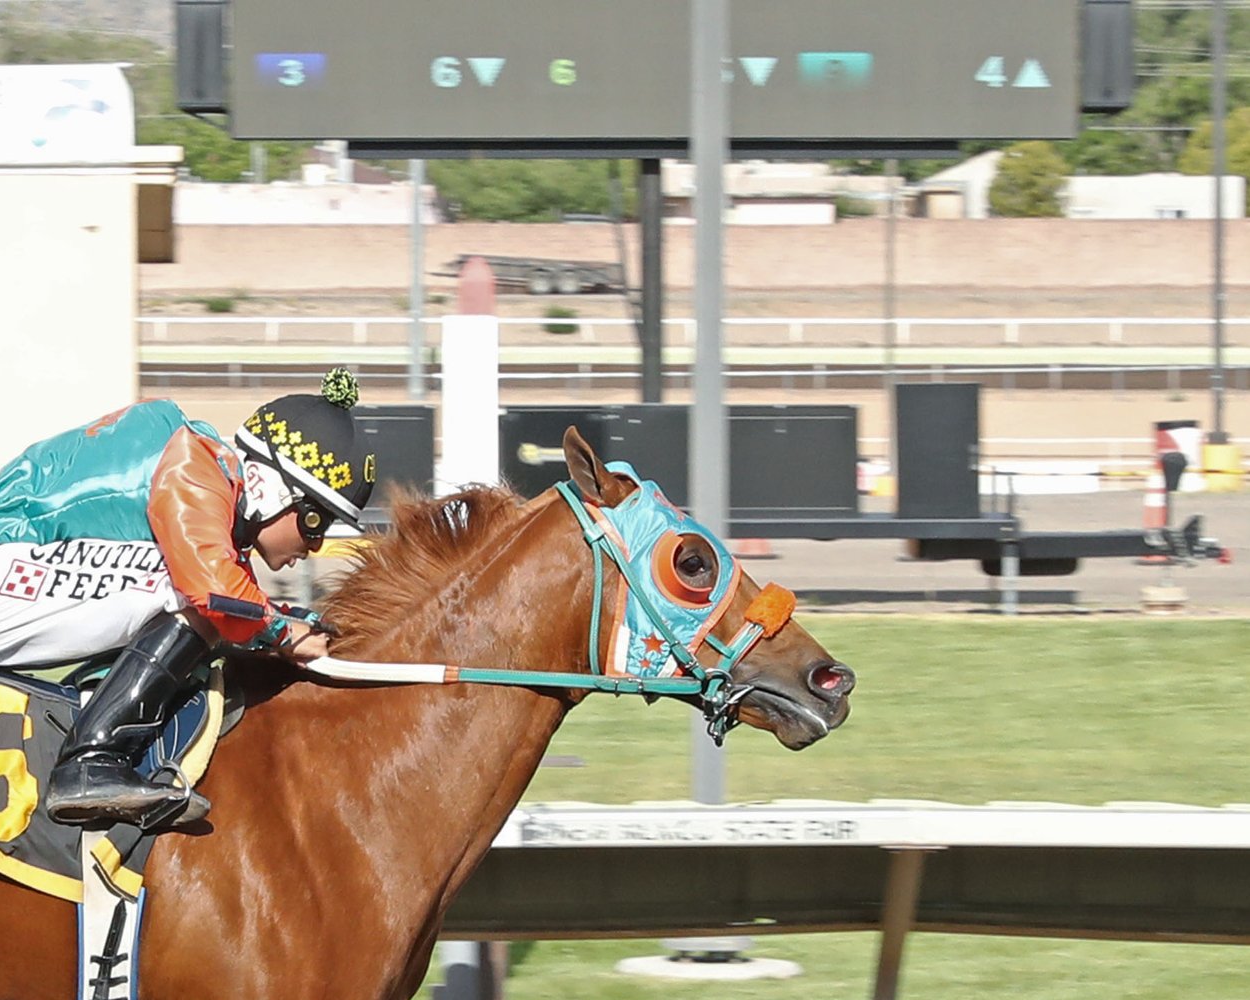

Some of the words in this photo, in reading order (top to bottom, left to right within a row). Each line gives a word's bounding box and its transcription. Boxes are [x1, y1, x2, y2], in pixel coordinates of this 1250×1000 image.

[277, 58, 306, 87] 3
[430, 56, 463, 88] 6
[549, 58, 578, 86] 6
[974, 55, 1008, 88] 4
